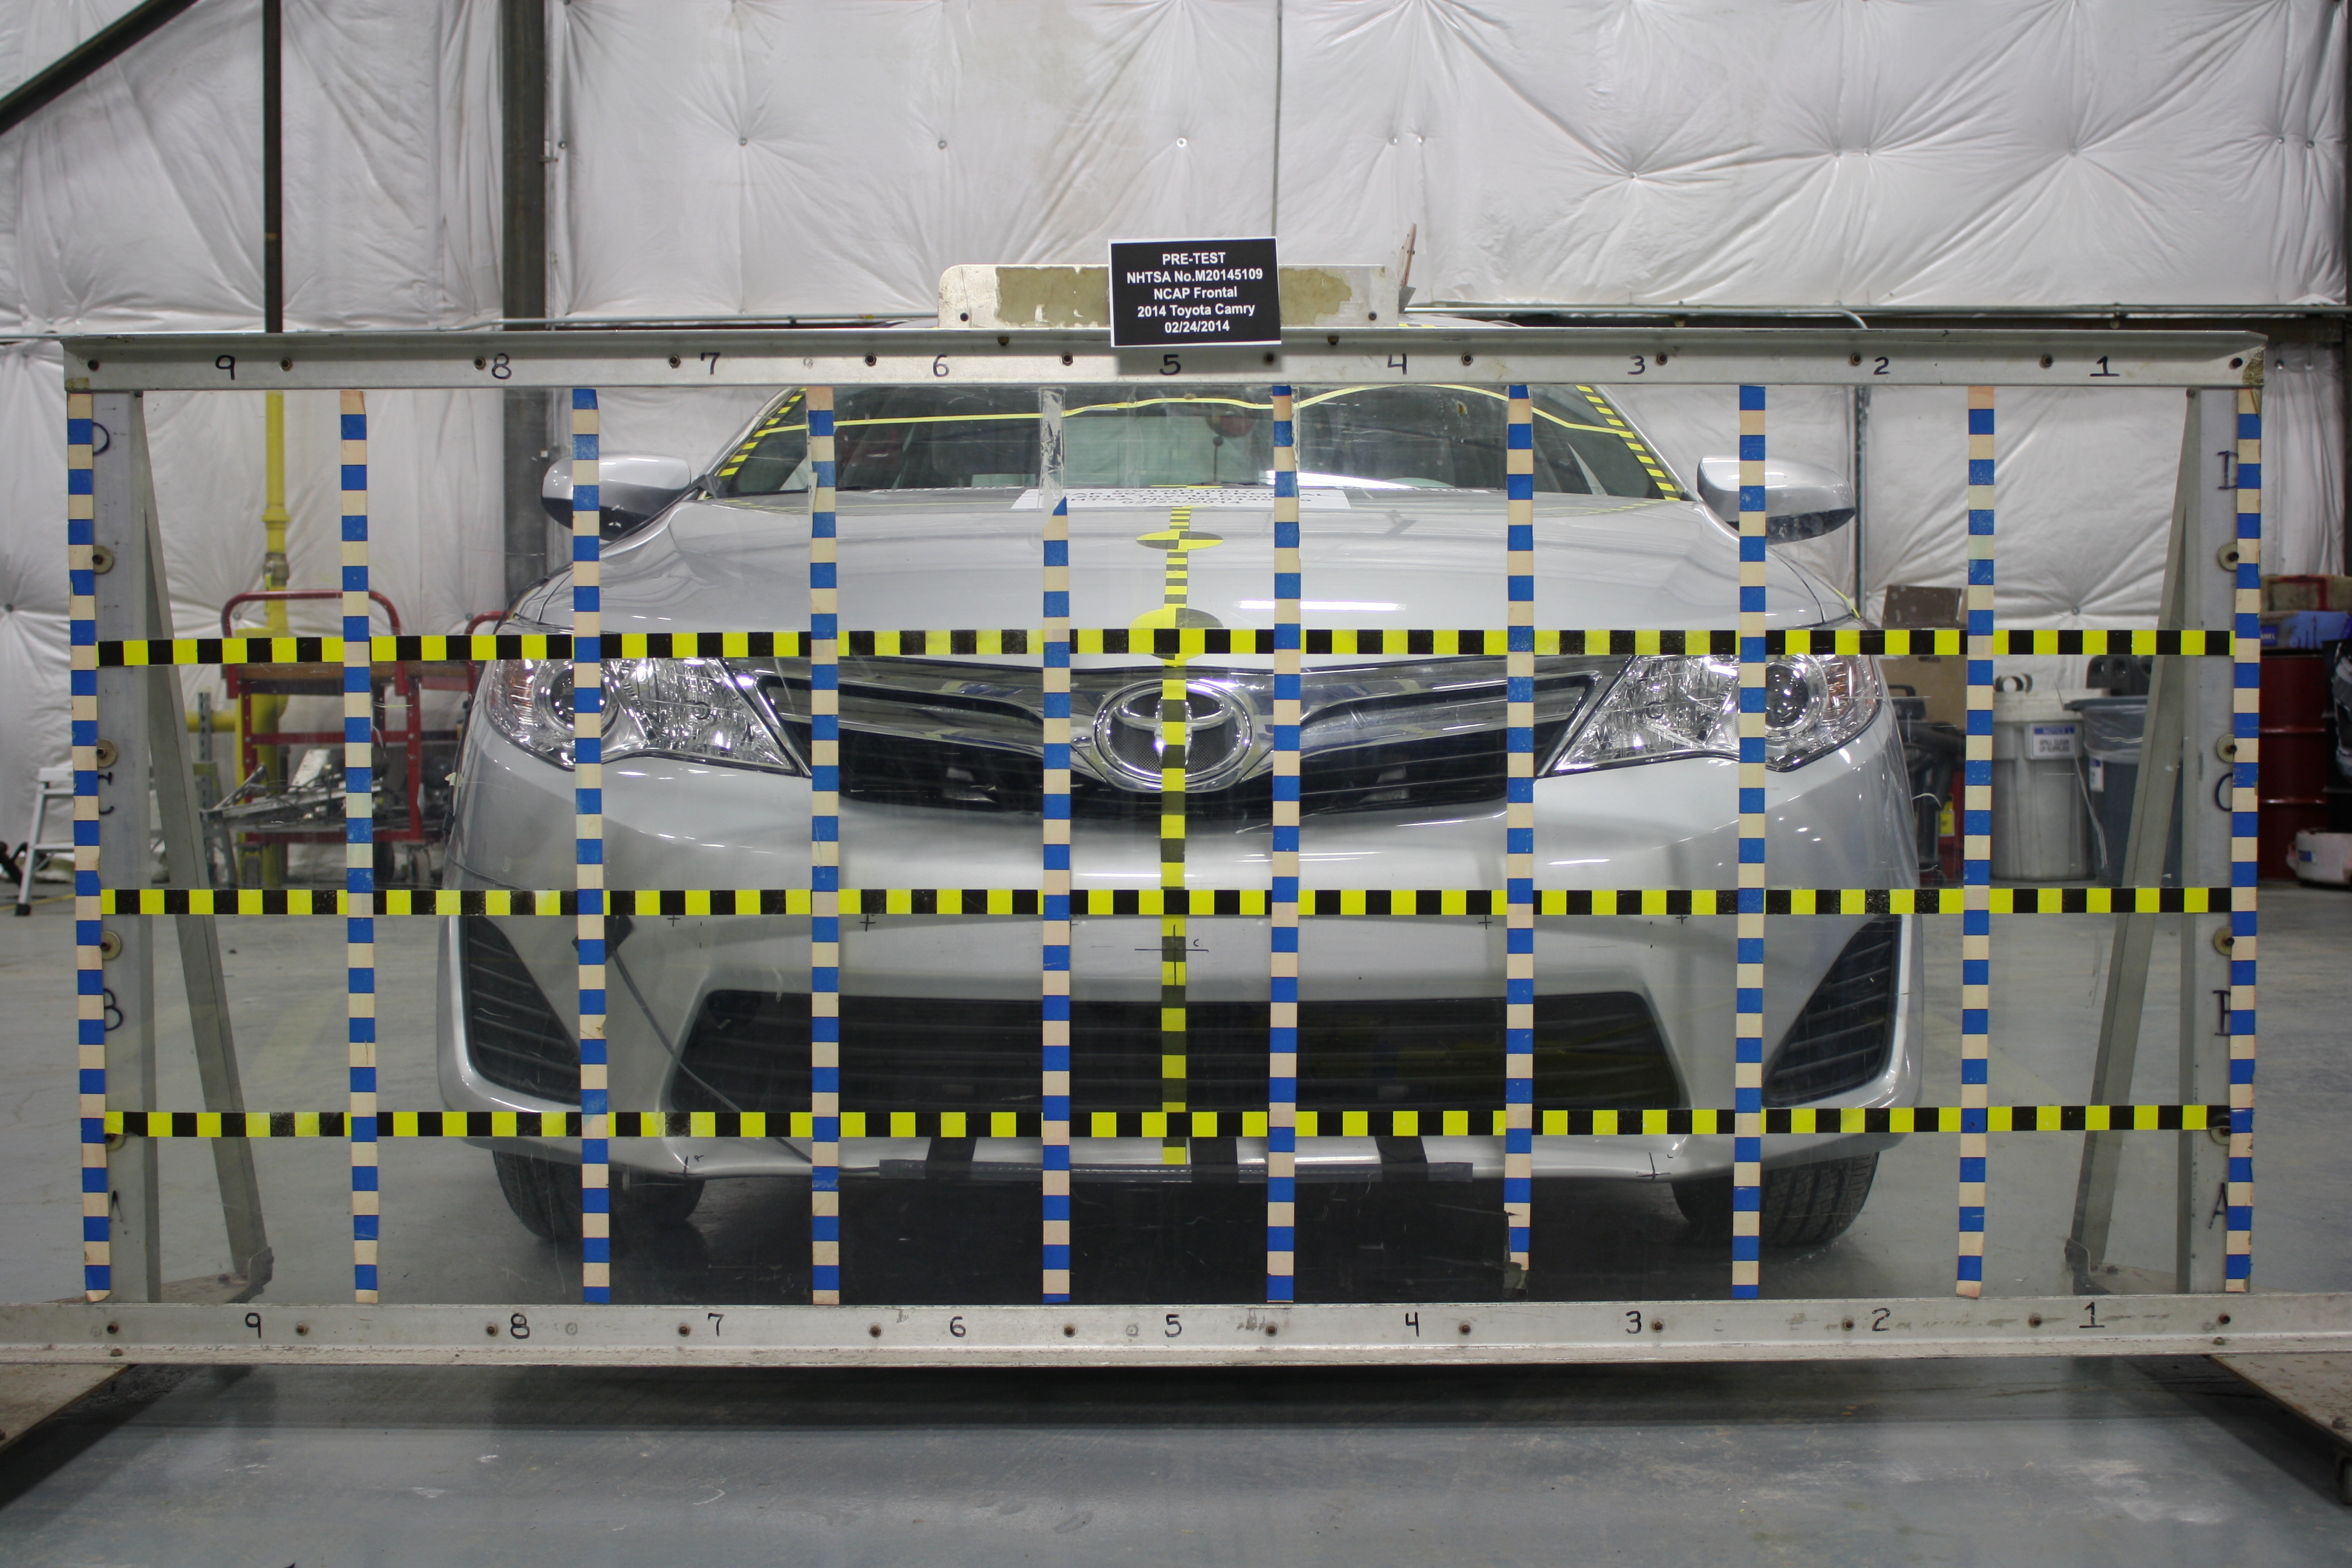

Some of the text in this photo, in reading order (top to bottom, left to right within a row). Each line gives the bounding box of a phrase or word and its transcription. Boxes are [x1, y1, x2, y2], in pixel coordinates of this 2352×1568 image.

[1162, 252, 1226, 265] PRE-TEST
[1127, 271, 1171, 284] NHTSA
[1154, 286, 1237, 299] NCAP Frontal
[1137, 303, 1255, 318] 2014 Toyota Camry
[1165, 320, 1230, 333] 02/24/2014
[215, 351, 2120, 381] 9 8 7 6 5 4 3 2 1
[244, 1301, 2105, 1339] 9 8 7 6 5 4 3 2 1
